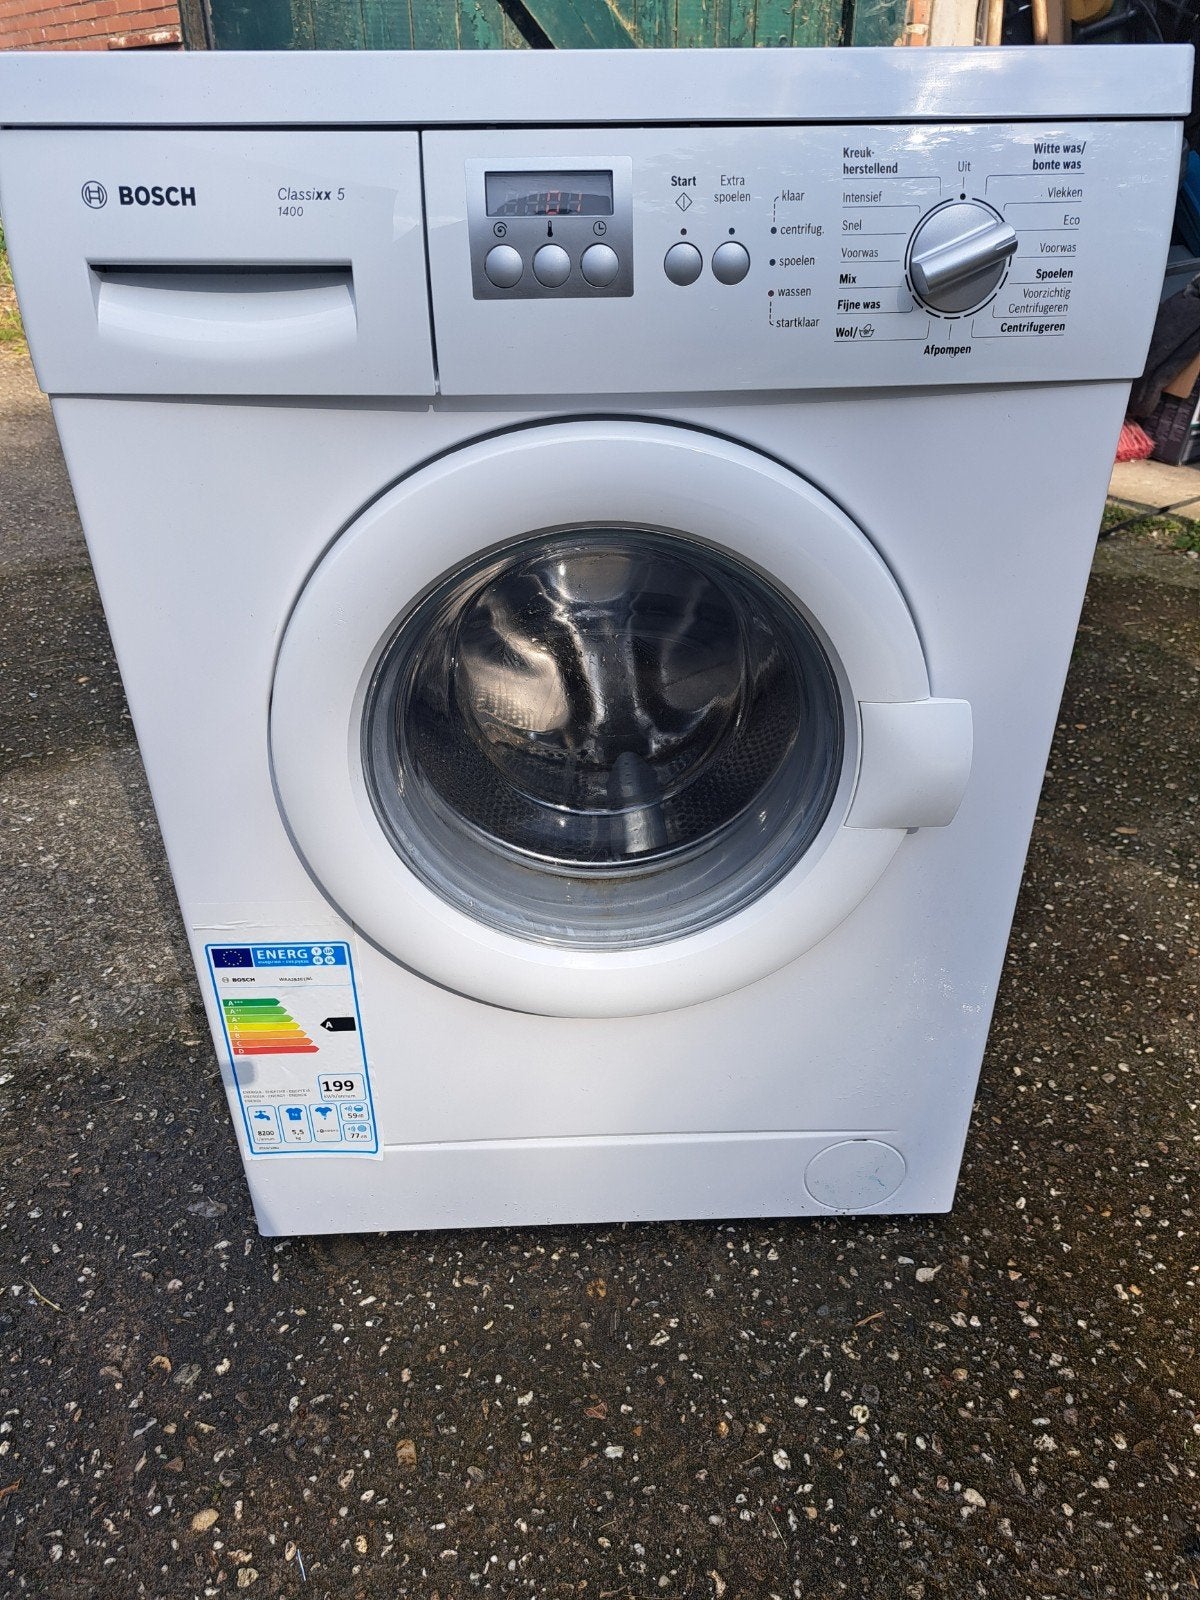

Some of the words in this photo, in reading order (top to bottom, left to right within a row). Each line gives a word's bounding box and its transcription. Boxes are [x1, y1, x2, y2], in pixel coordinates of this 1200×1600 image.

[842, 148, 875, 159] Kreuk-
[1033, 143, 1060, 154] Witte
[1062, 141, 1087, 154] was/
[842, 162, 899, 175] herstellend
[957, 160, 972, 172] Uit
[1032, 160, 1060, 171] bonte
[1062, 159, 1082, 170] was
[670, 175, 697, 187] Start
[720, 174, 745, 187] Extra
[118, 186, 197, 206] BOSCH
[277, 187, 332, 202] Classixx
[337, 188, 345, 201] 5
[713, 191, 752, 204] spoelen
[781, 189, 806, 202] klaar
[842, 192, 883, 204] Intensief
[1047, 187, 1083, 199] Vlekken
[277, 206, 304, 217] 1400
[842, 219, 863, 232] Snel
[1063, 215, 1081, 226] Eco
[780, 223, 825, 237] centrifug.
[841, 247, 879, 259] Voorwas
[1039, 243, 1077, 254] Voorwas
[779, 255, 816, 269] spoelen
[839, 273, 857, 285] Mix
[1035, 268, 1074, 281] Spoelen
[777, 286, 812, 297] wassen
[1023, 286, 1071, 299] Voorzichtig
[837, 300, 860, 312] Fijne
[862, 300, 881, 310] was
[1008, 301, 1069, 315] Centrifugeren
[776, 316, 821, 329] startklaar
[1000, 321, 1066, 335] Centrifugeren
[835, 325, 858, 339] Wol/
[923, 344, 972, 358] Afpompen
[256, 949, 308, 960] ENERG
[325, 1021, 333, 1029] A
[322, 1080, 354, 1092] 199
